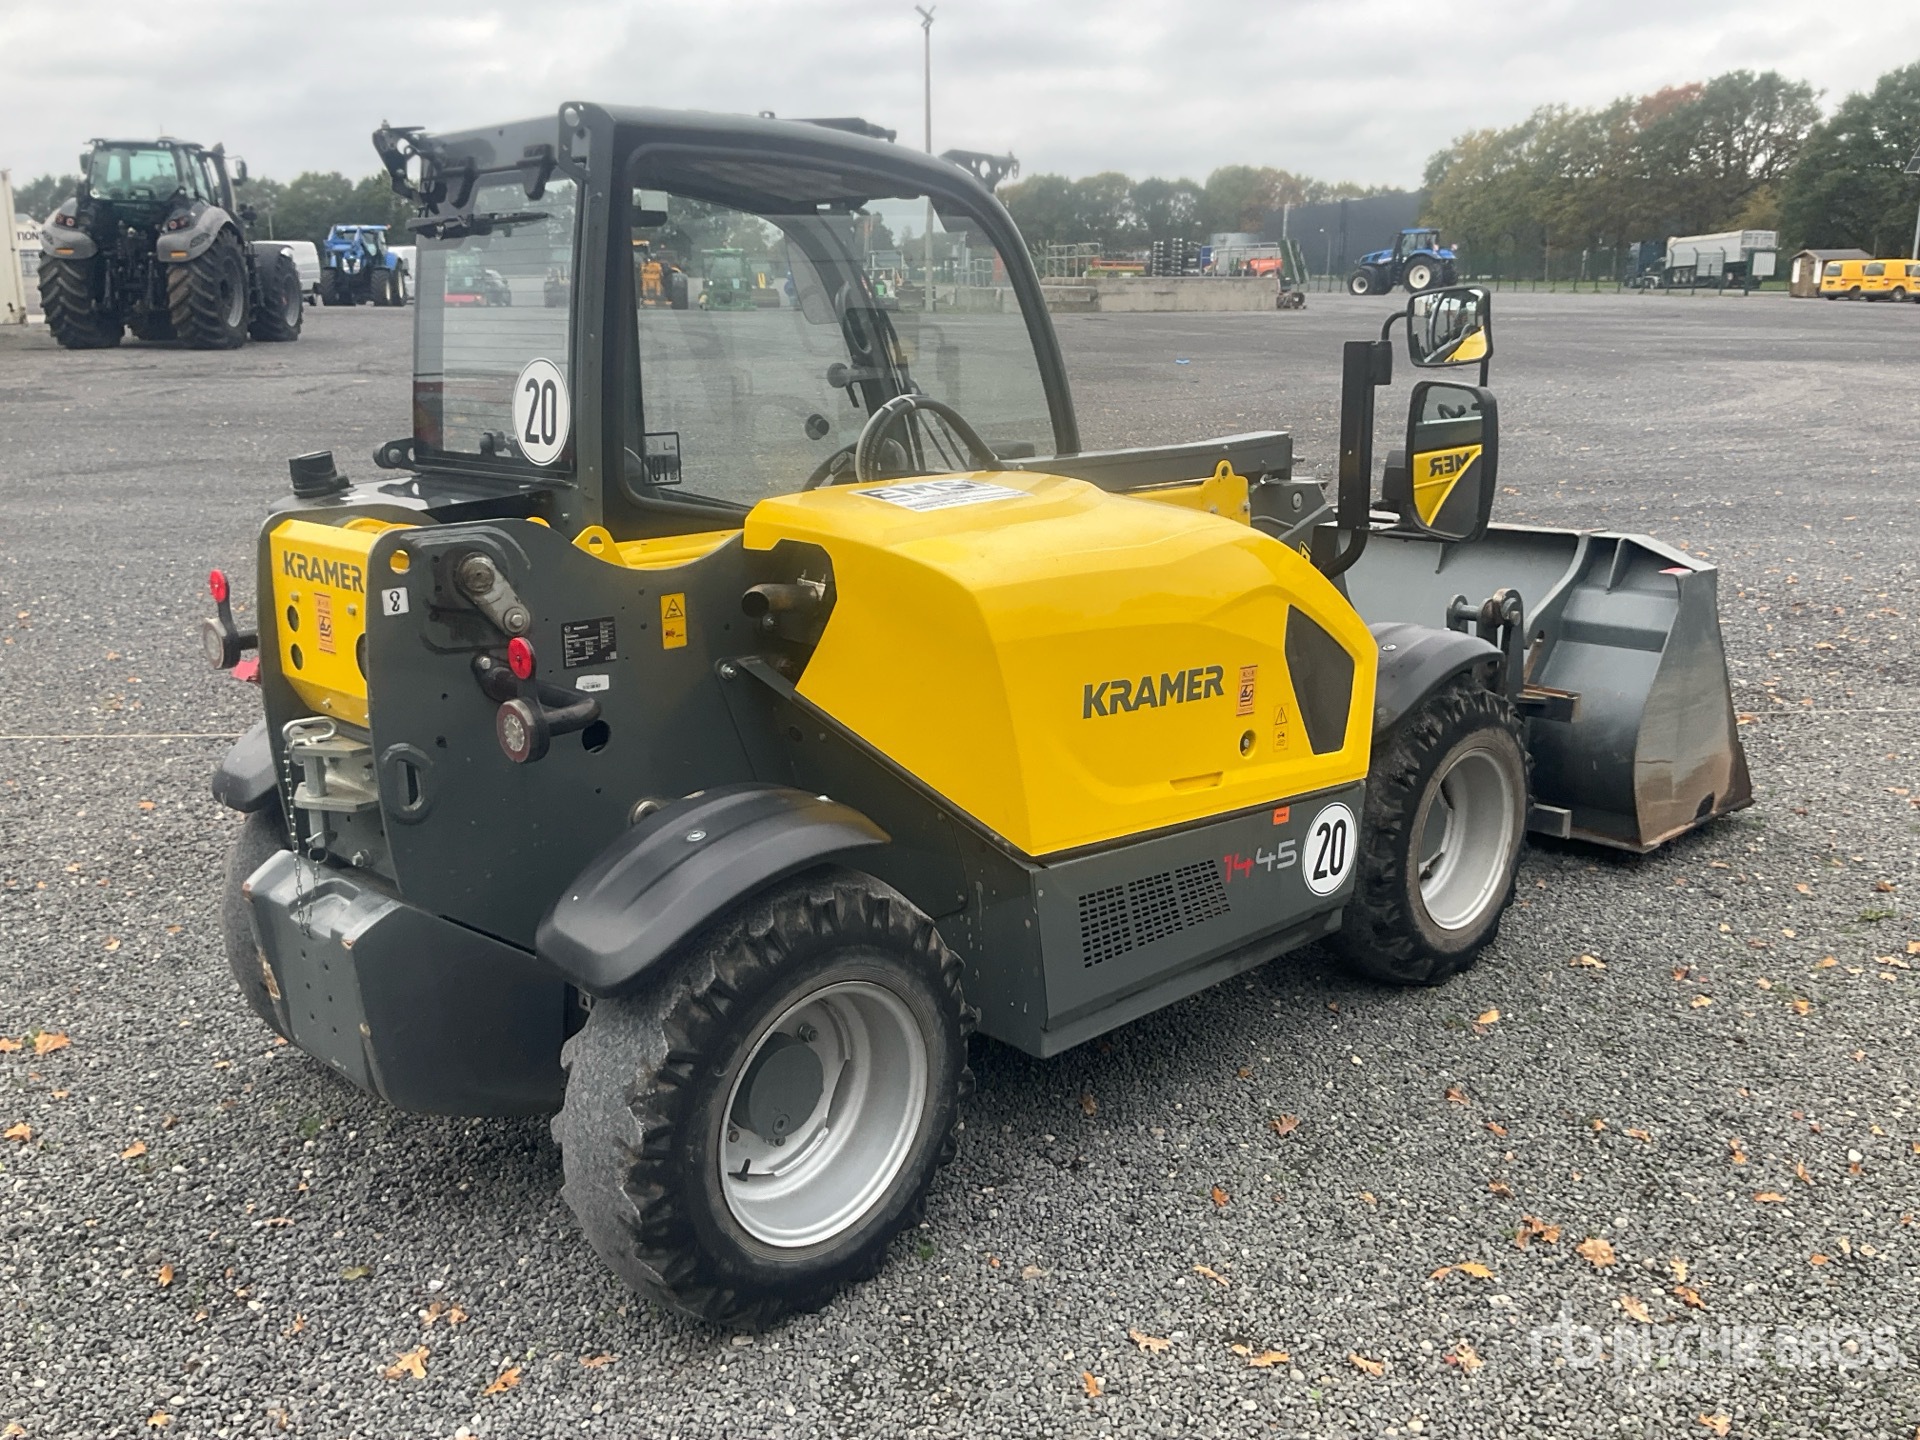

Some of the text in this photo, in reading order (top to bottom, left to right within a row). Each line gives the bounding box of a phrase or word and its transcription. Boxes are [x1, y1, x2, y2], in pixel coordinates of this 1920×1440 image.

[525, 378, 557, 446] 20
[283, 550, 365, 594] KRAMER
[1083, 665, 1225, 719] KRAMER
[1224, 839, 1297, 883] 1445
[1313, 819, 1346, 880] 20
